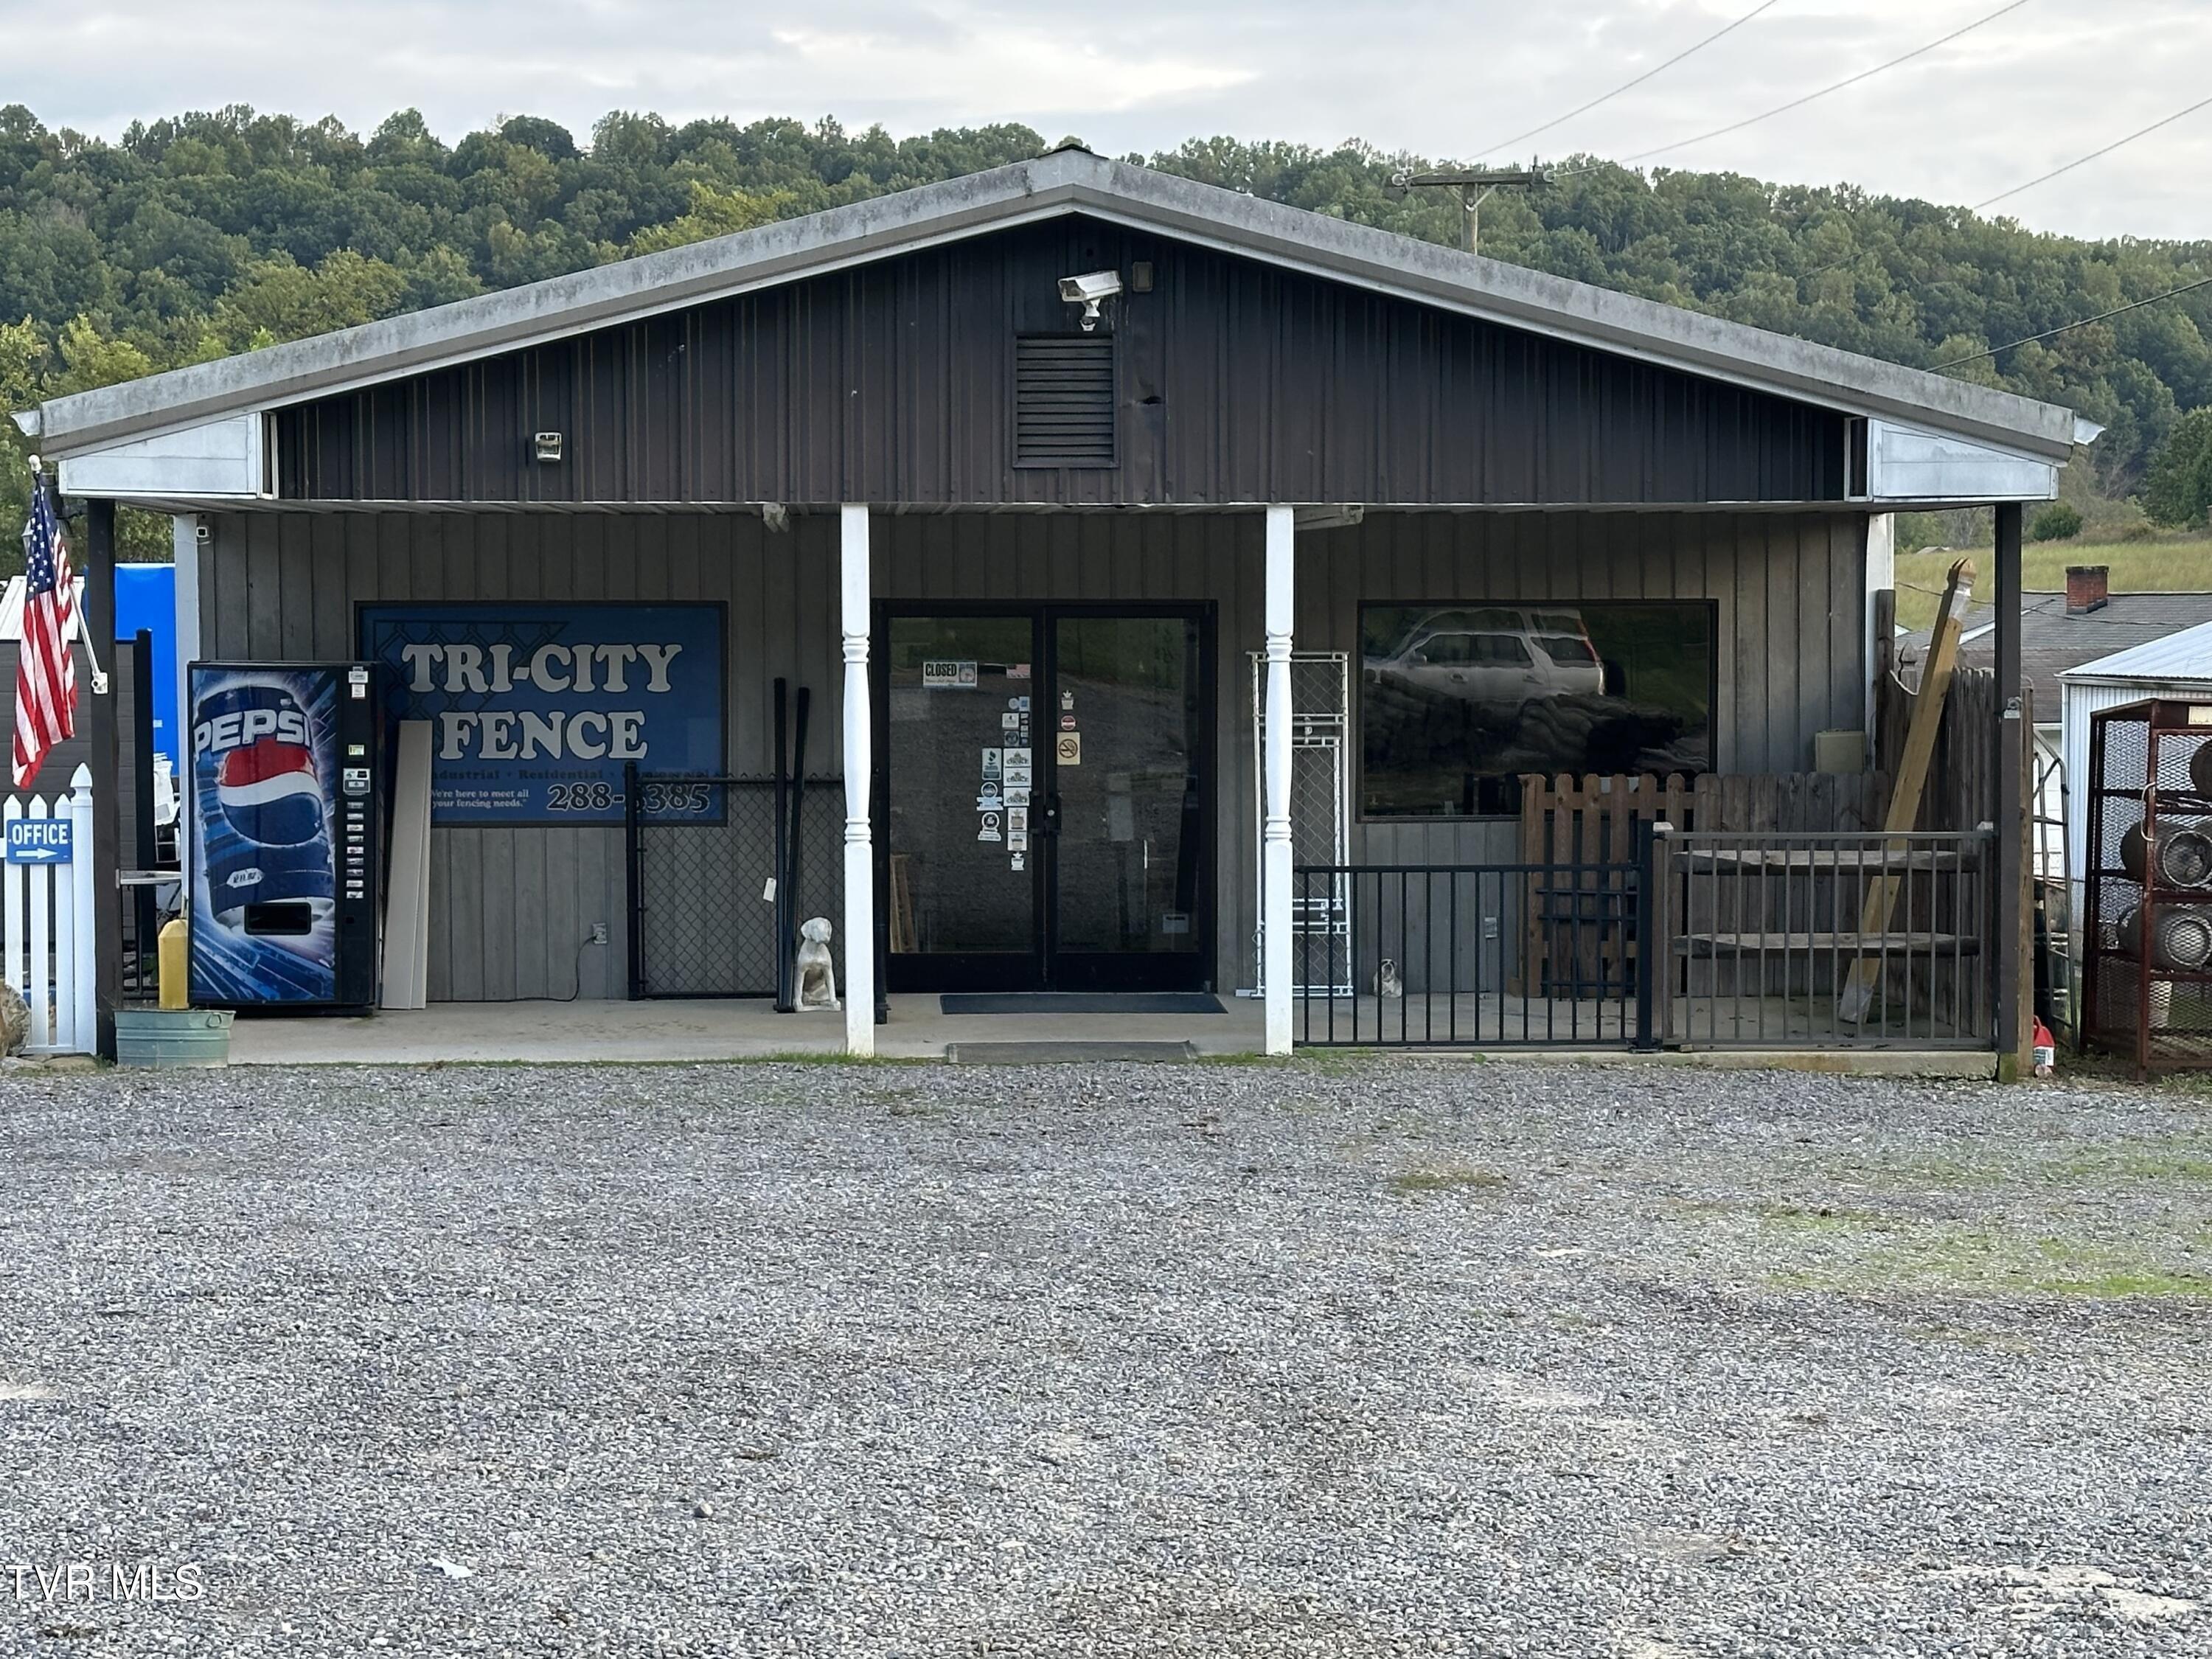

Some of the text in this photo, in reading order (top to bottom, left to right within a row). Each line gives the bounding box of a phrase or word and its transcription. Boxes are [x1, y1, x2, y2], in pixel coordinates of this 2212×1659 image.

[401, 644, 683, 693] TRI-CITY
[925, 664, 957, 677] CLOSED
[194, 709, 310, 764] PEPSI
[439, 710, 648, 760] FENCE
[433, 769, 603, 781] dustrial Residential
[456, 789, 476, 798] here
[479, 790, 488, 798] to
[491, 790, 514, 798] meet
[517, 788, 529, 798] all
[456, 799, 491, 810] fencing
[12, 824, 69, 845] OFFICE
